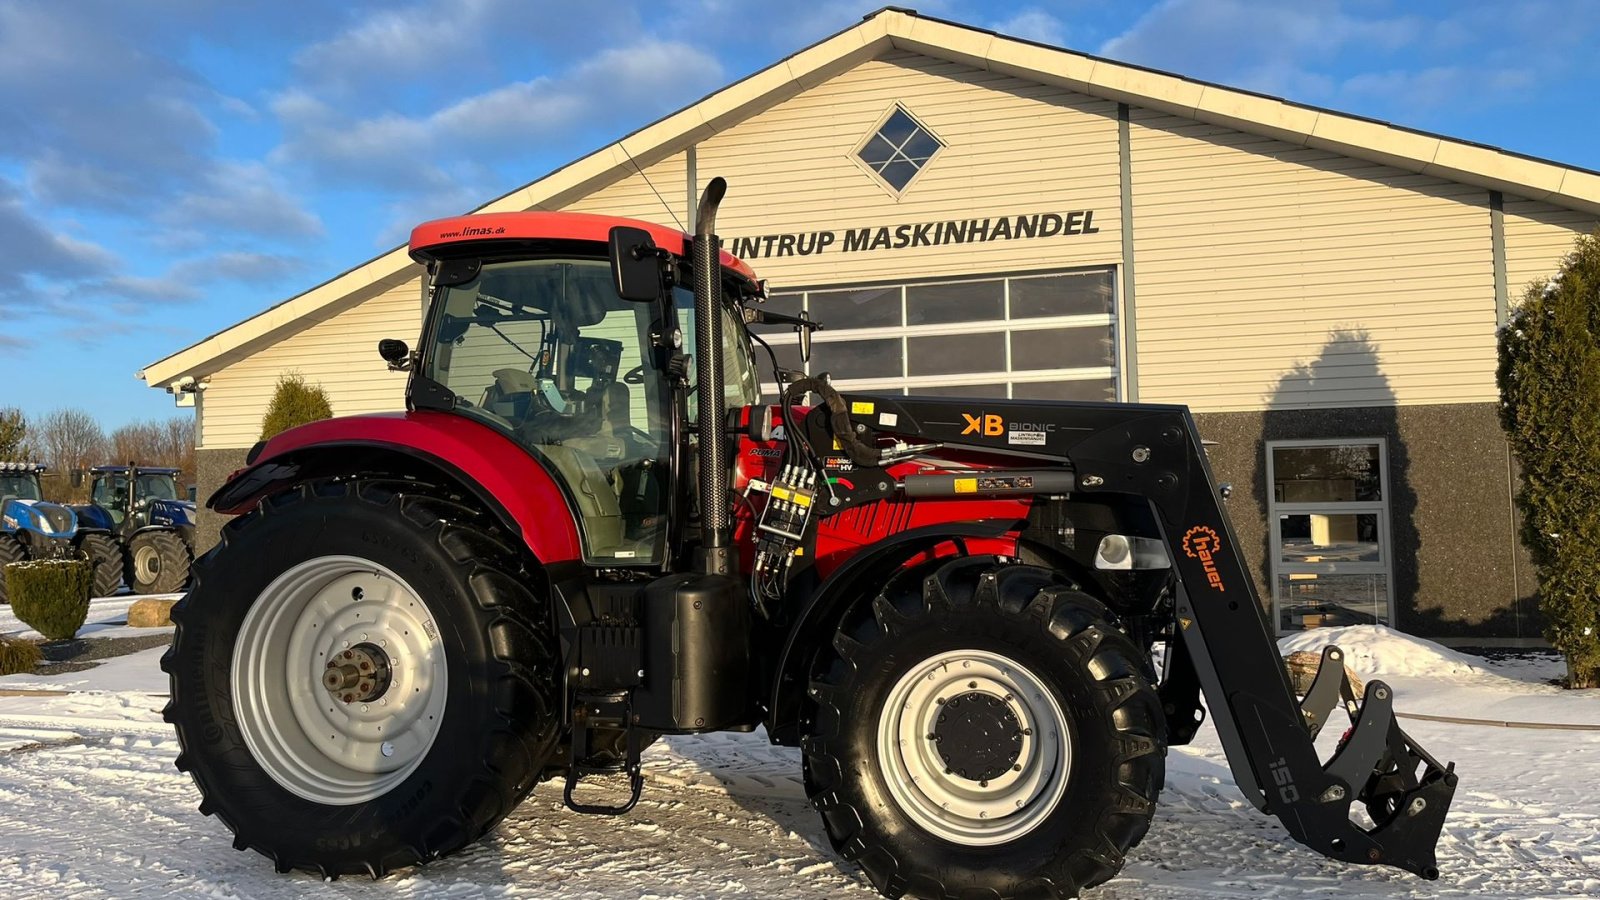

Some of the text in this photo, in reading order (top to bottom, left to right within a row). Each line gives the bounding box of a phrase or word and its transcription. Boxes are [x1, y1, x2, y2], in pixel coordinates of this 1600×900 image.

[440, 226, 506, 239] www.limas.dk
[720, 210, 1100, 260] INTRUP MASKINHANDEL
[1009, 422, 1056, 432] BIONIC
[749, 447, 781, 457] PUMA
[1192, 534, 1225, 592] hauer
[1268, 756, 1300, 804] 150
